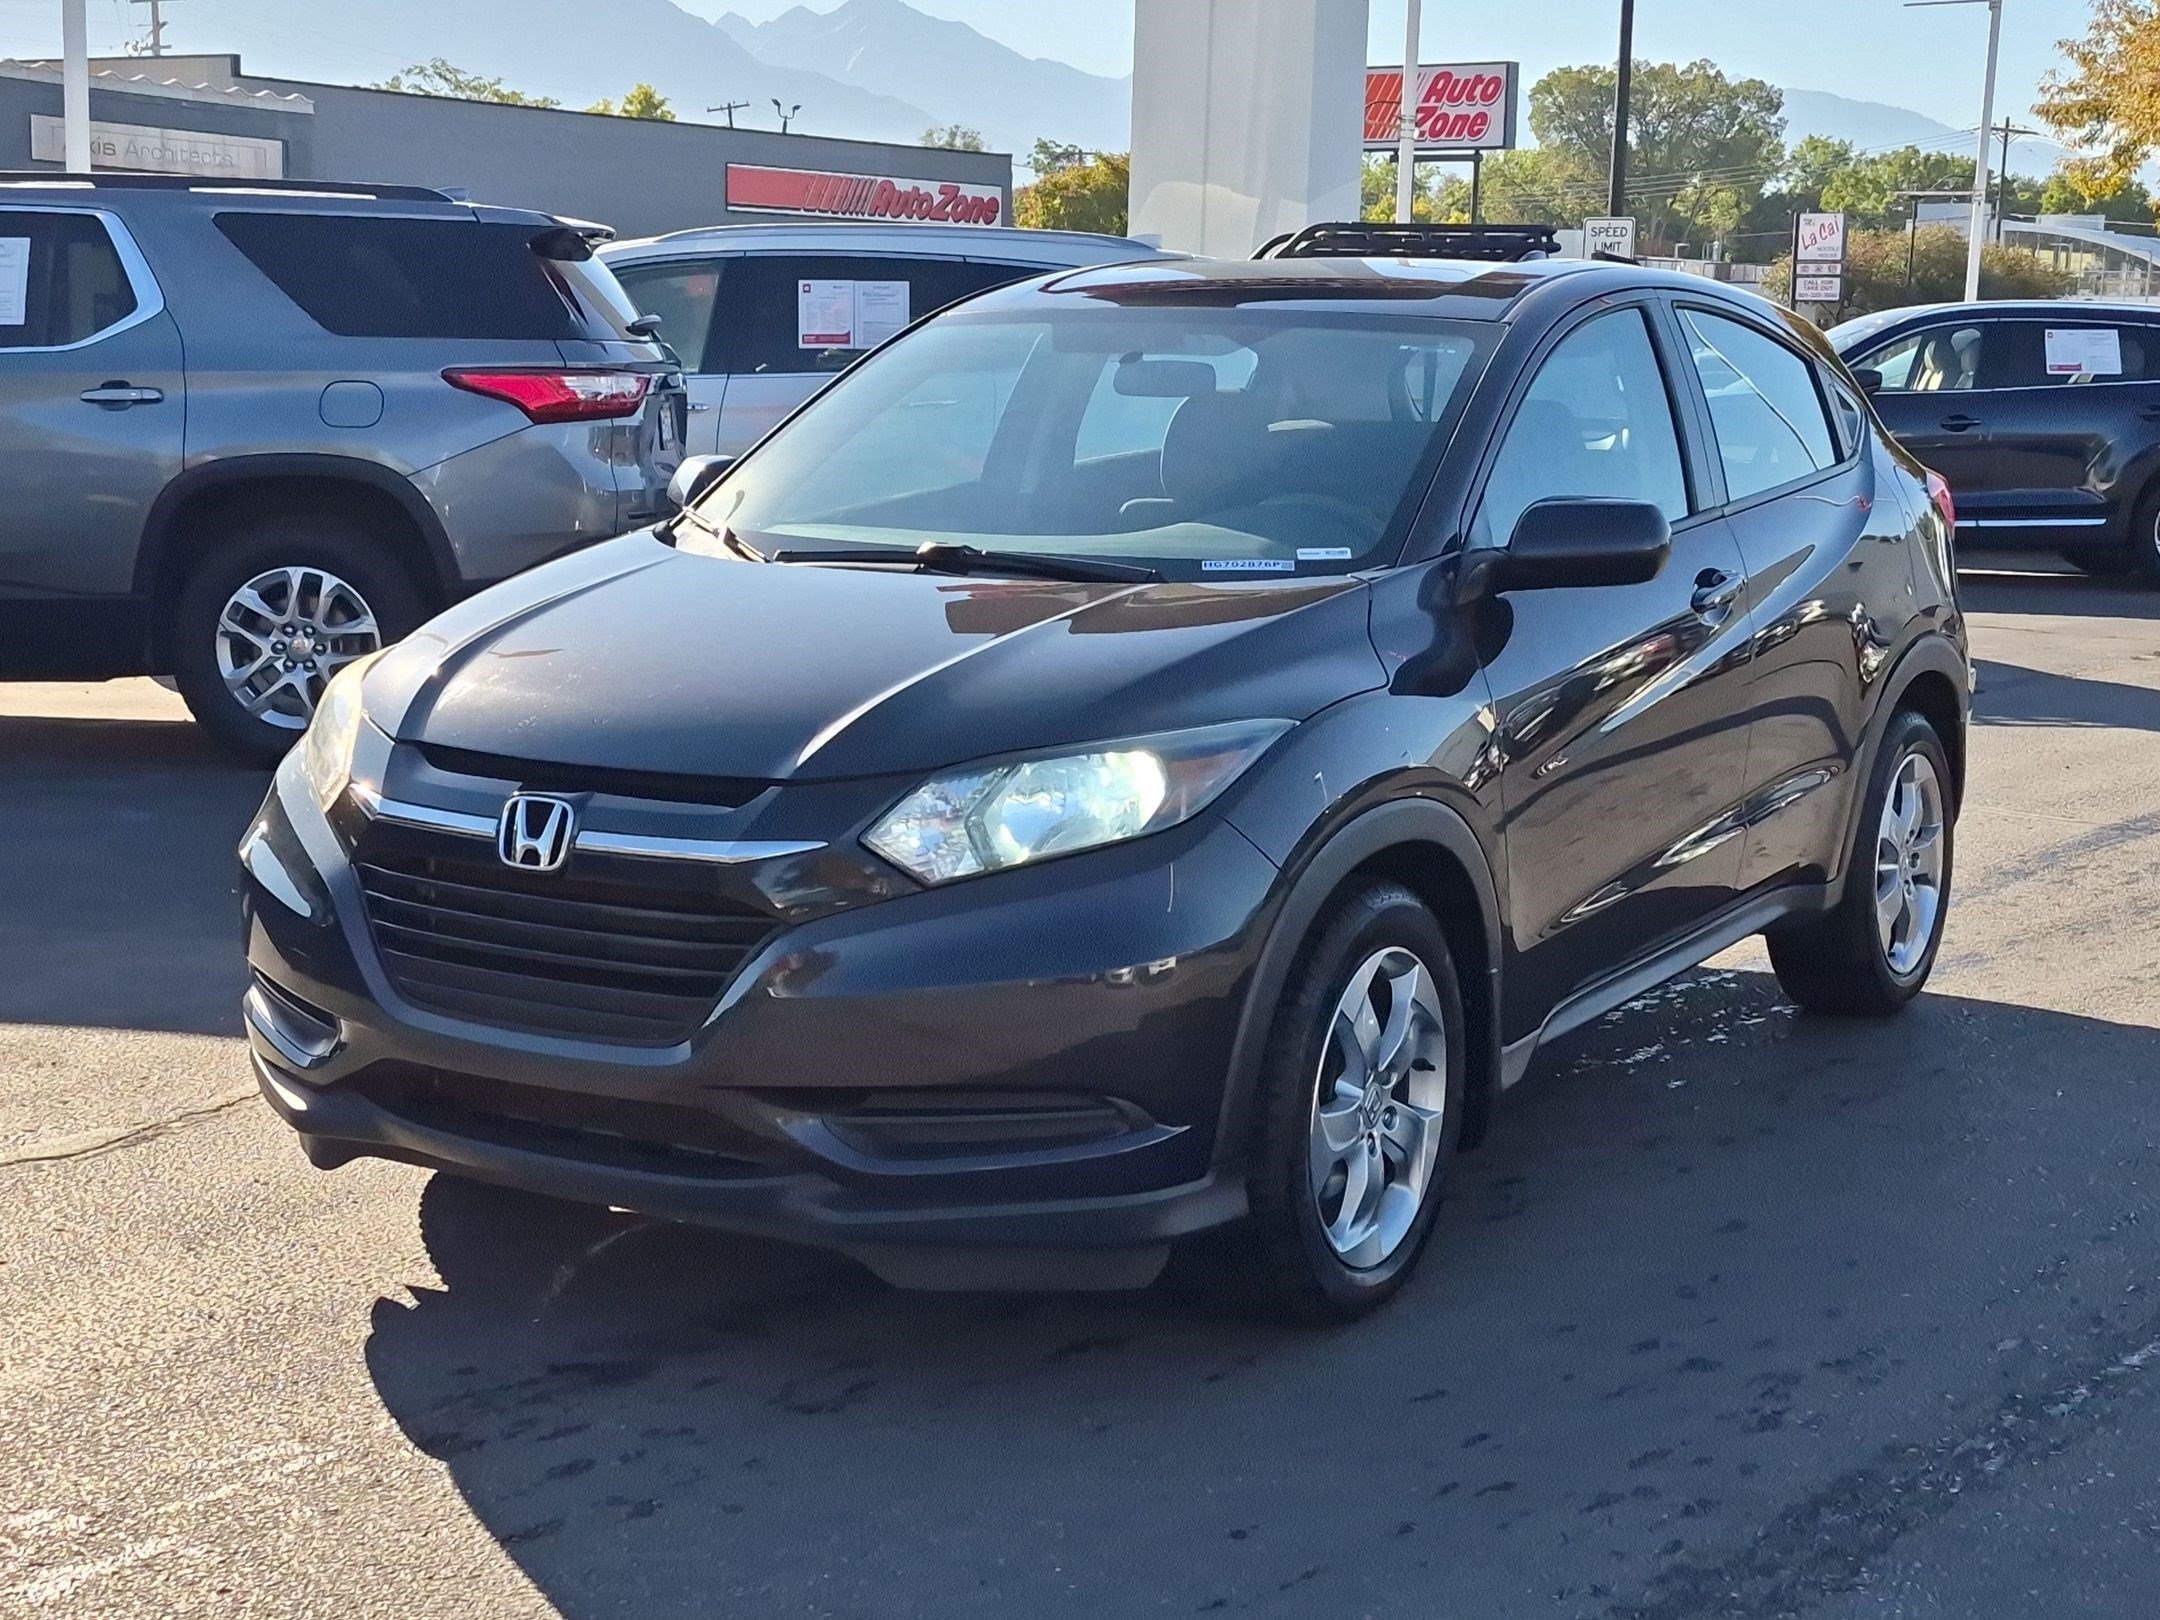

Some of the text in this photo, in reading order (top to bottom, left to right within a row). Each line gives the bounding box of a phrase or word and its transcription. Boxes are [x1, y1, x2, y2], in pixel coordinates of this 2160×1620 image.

[1421, 70, 1503, 105] Auto
[1415, 105, 1490, 140] Zone
[124, 140, 233, 167] Architects
[868, 179, 999, 225] AutoZone
[1590, 226, 1628, 238] SPEED
[1801, 232, 1818, 250] La
[1819, 215, 1839, 240] Cai
